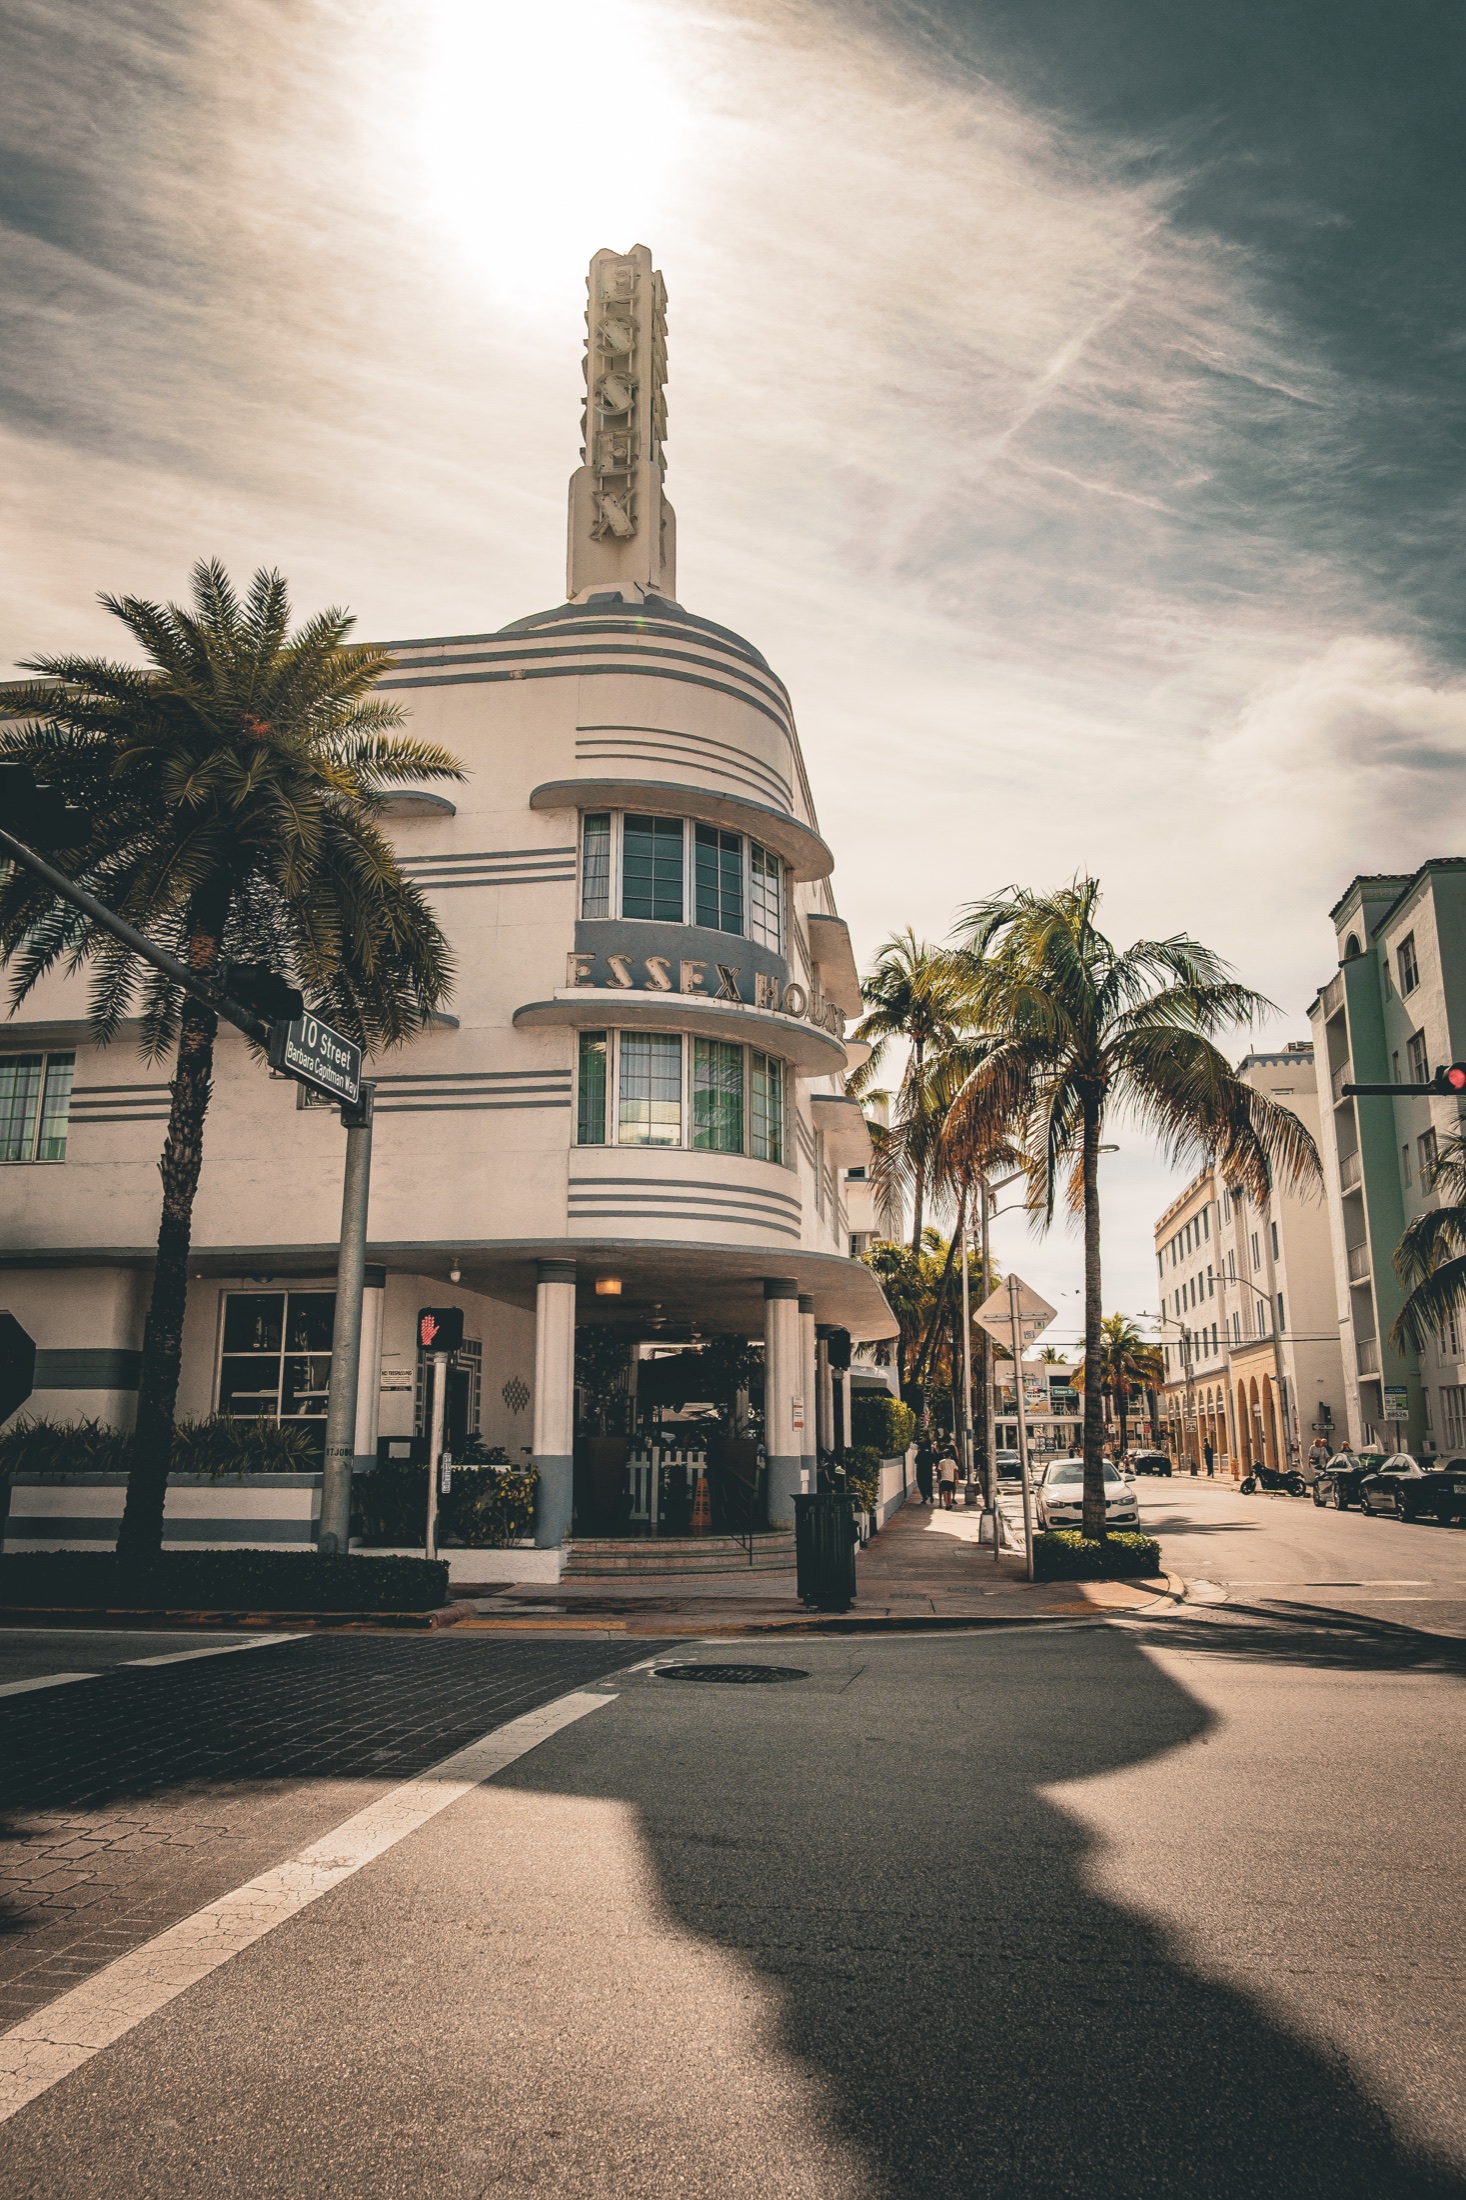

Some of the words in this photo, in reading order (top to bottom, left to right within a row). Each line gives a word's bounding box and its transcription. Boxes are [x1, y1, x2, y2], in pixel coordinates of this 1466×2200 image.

[590, 254, 638, 541] ESSEX
[566, 952, 742, 1002] ESSEX
[287, 1041, 314, 1071] Barbara
[314, 1057, 344, 1088] Capitman
[344, 1074, 358, 1099] Way
[301, 1016, 318, 1048] 10
[320, 1033, 352, 1071] Street
